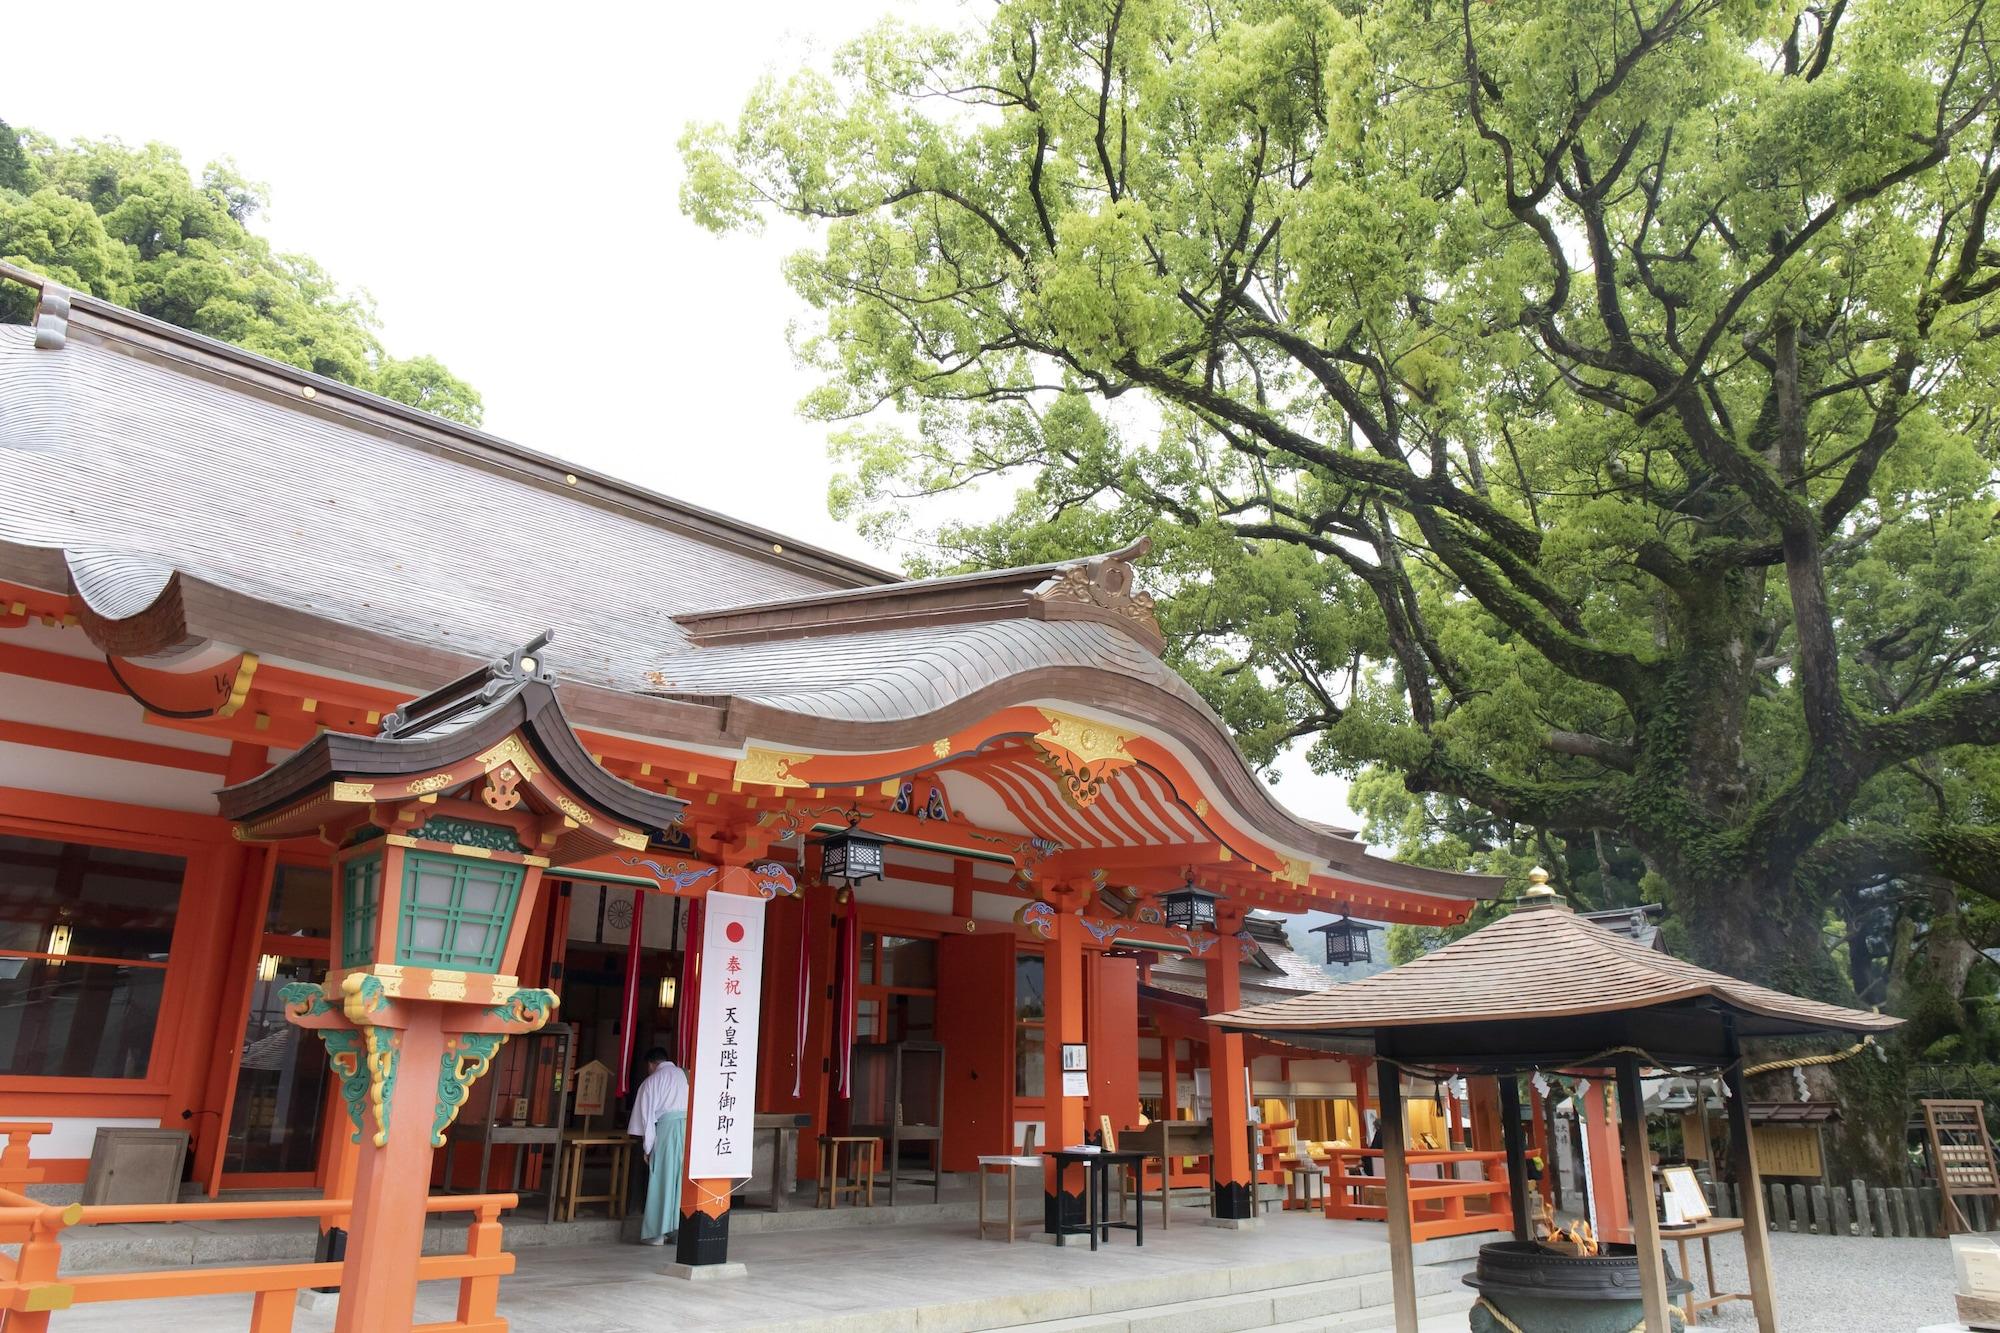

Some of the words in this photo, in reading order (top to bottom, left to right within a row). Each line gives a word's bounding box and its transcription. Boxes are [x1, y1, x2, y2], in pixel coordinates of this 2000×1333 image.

[724, 956, 742, 995] 奉祝
[715, 1007, 739, 1156] 天皇陛下御即位
